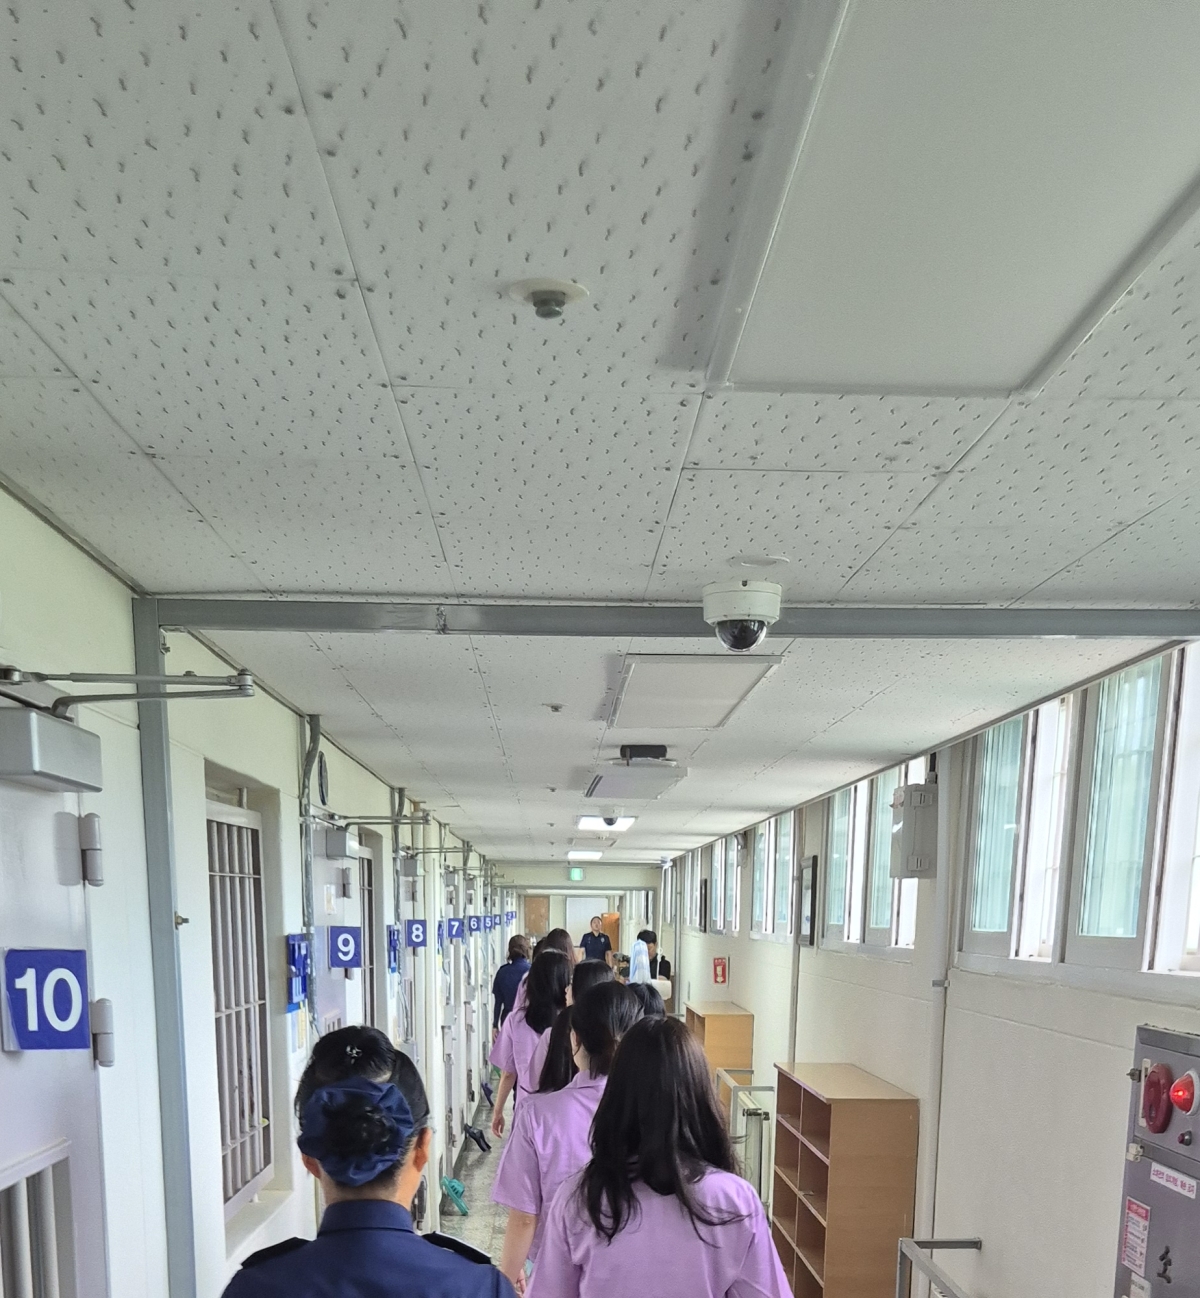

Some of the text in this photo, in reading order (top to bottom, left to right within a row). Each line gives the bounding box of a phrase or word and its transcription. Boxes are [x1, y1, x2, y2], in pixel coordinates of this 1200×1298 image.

[470, 917, 478, 930] 6
[485, 917, 492, 928] 5
[494, 915, 500, 925] 4
[411, 924, 424, 943] 8
[450, 921, 460, 935] 7
[337, 933, 356, 961] 9
[15, 967, 83, 1032] 10
